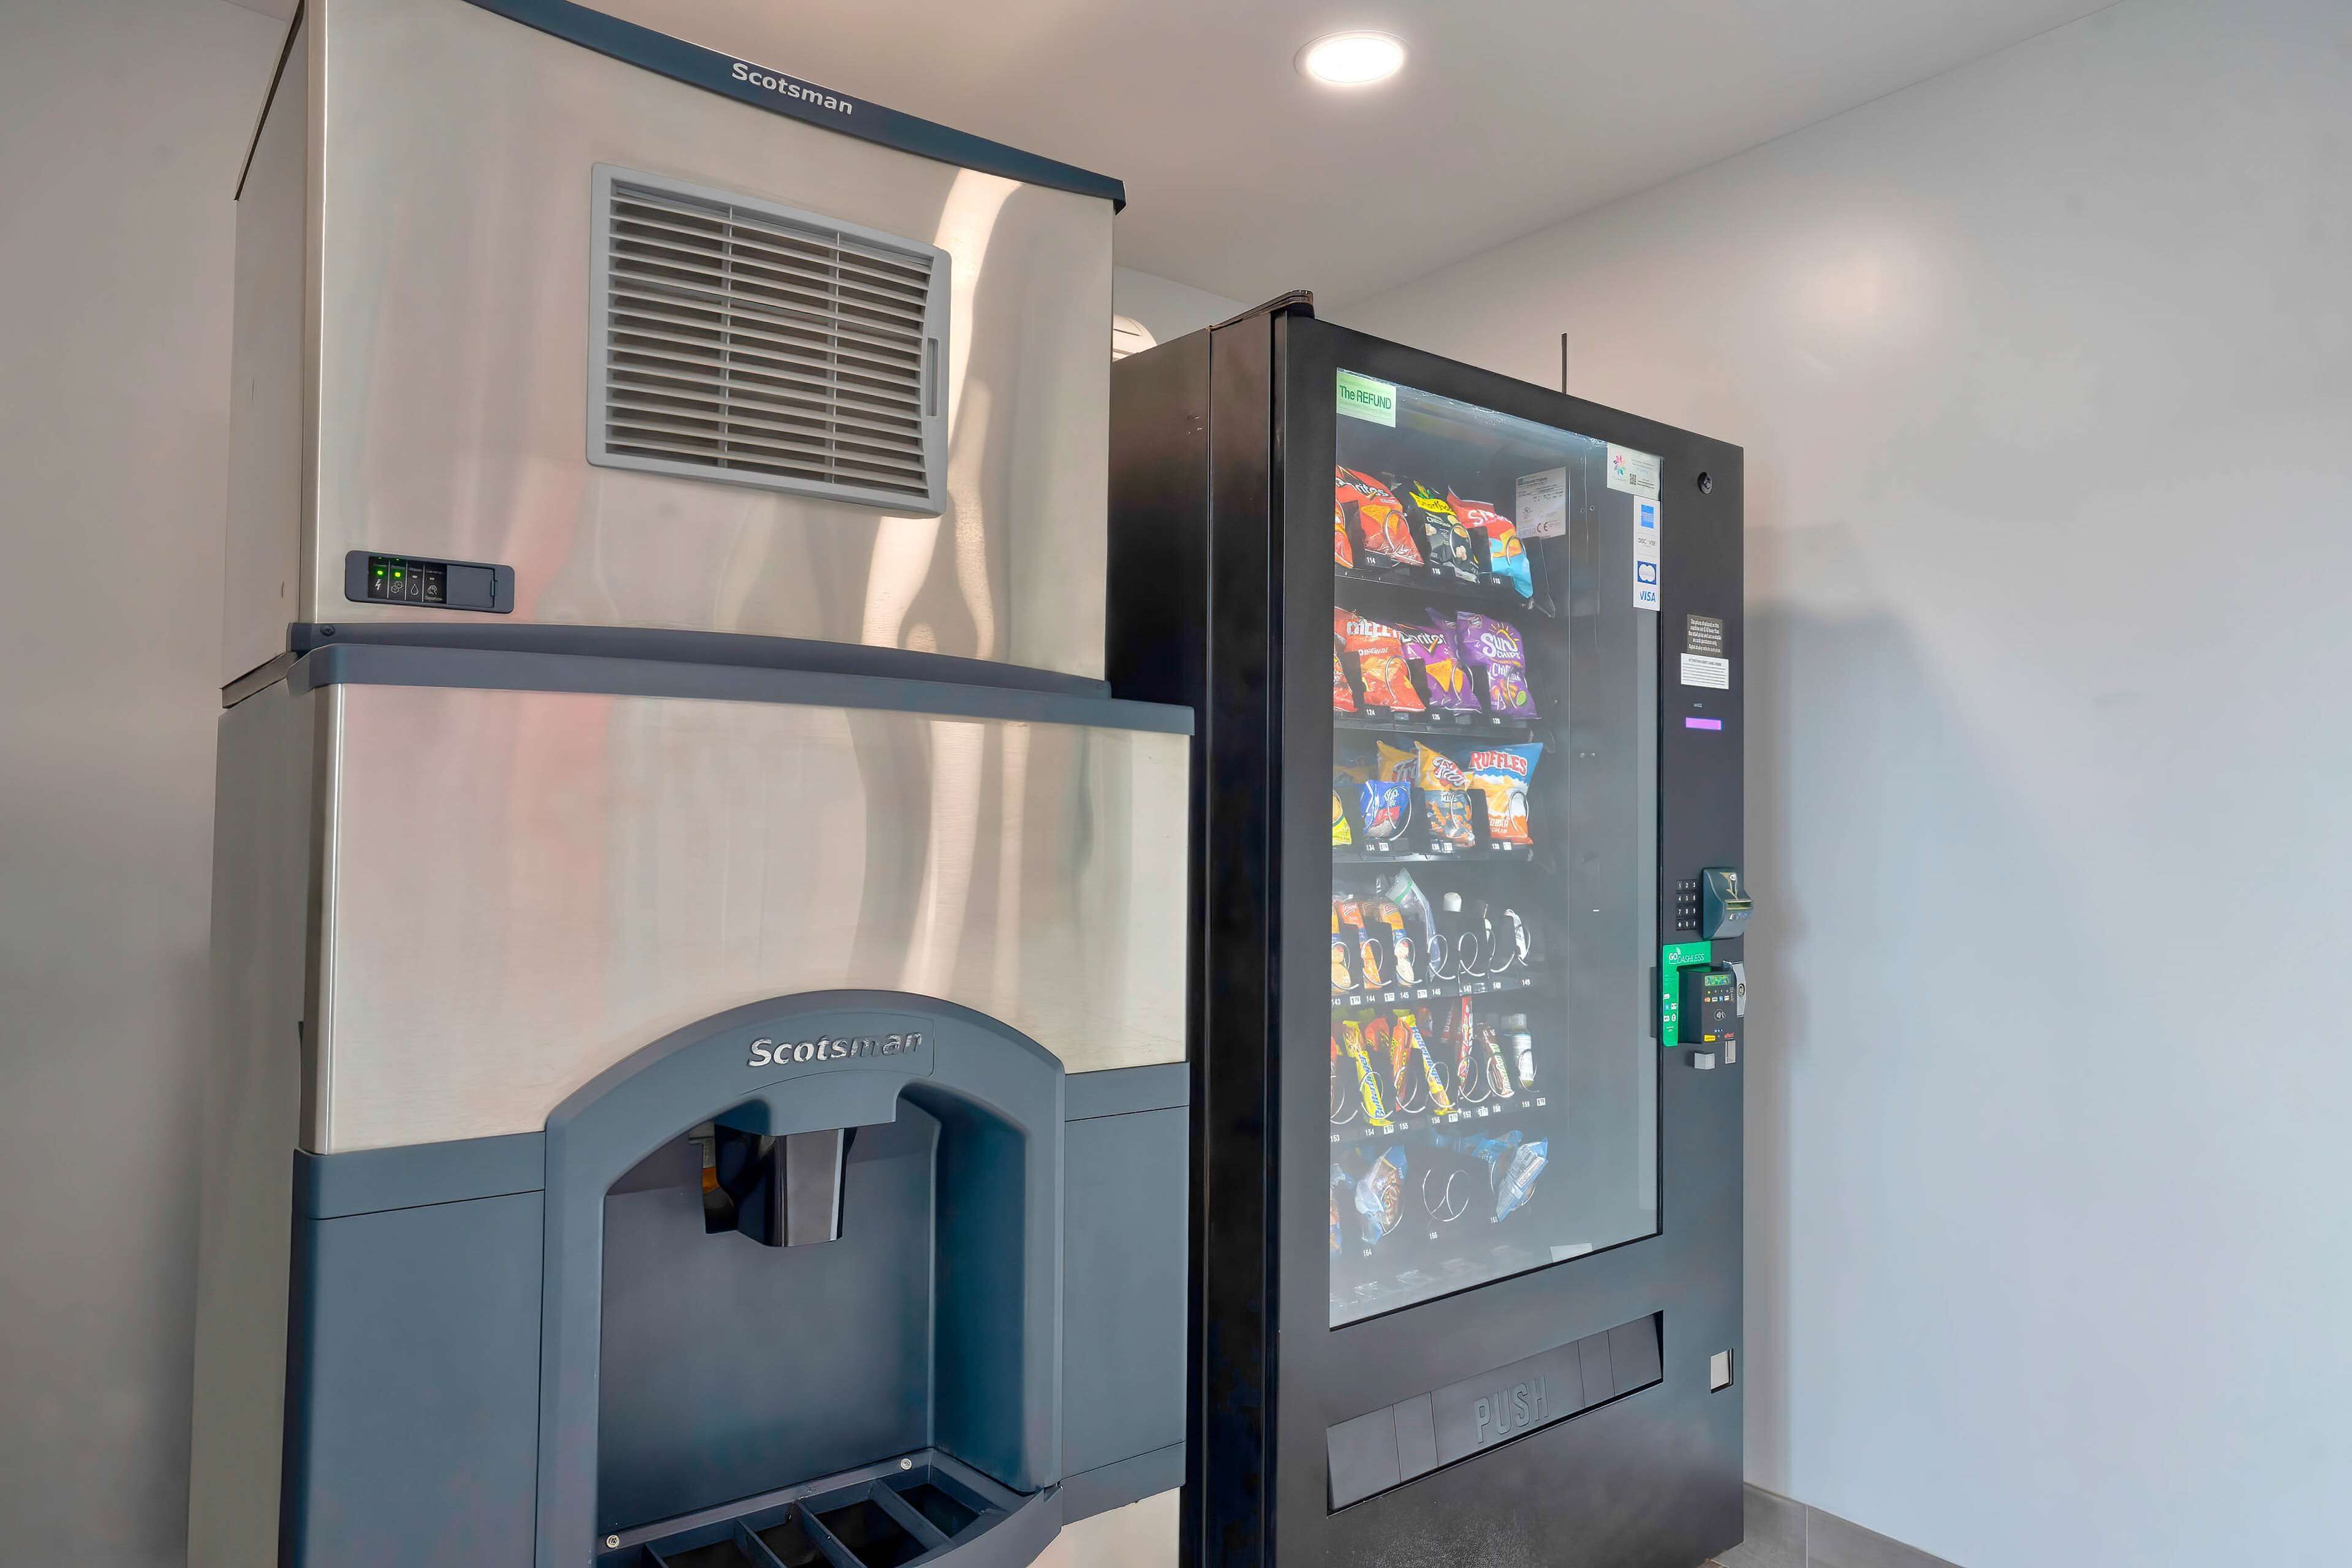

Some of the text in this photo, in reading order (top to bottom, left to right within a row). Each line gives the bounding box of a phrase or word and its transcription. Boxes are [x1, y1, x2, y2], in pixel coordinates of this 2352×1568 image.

[732, 62, 853, 115] Scotsman
[1339, 385, 1391, 409] The REFUND
[1639, 590, 1656, 602] VISA
[1469, 750, 1527, 776] RUFFLES
[1677, 954, 1704, 963] CASHLESS
[747, 1031, 923, 1067] Scotsman
[1473, 1375, 1549, 1443] PUSH
